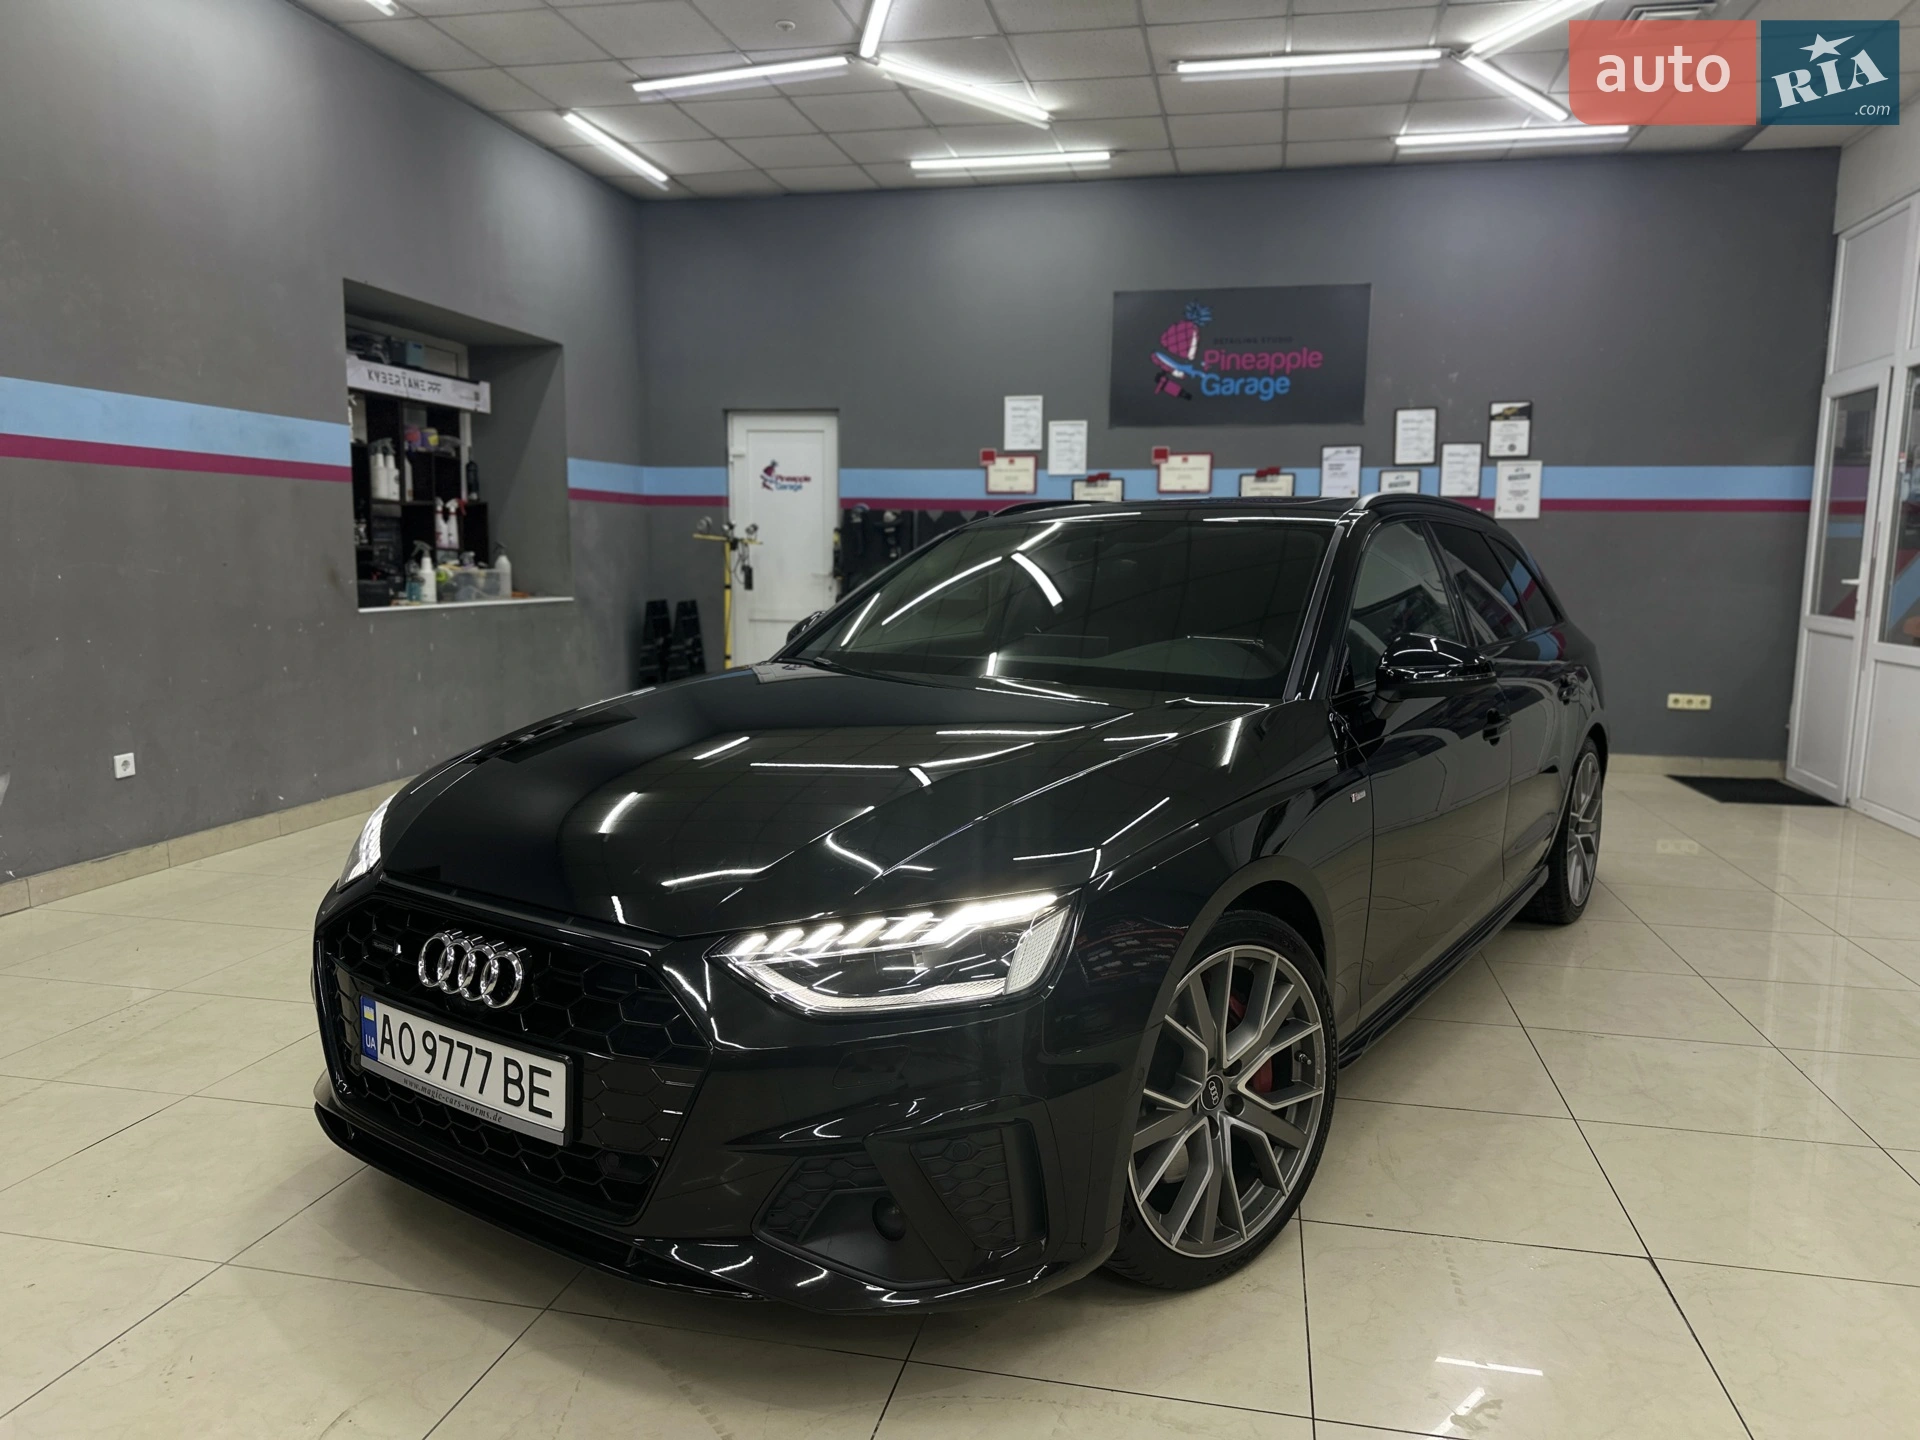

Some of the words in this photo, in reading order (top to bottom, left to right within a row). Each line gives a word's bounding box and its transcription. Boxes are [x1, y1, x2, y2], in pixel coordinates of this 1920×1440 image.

[1203, 346, 1323, 375] Pineapple
[1201, 373, 1290, 401] Garage
[776, 474, 812, 483] Pineapple
[365, 1033, 377, 1051] UA
[380, 1014, 415, 1065] AO
[422, 1030, 492, 1095] 9777
[503, 1057, 553, 1119] BE
[403, 1077, 503, 1123] www.magic-cars-worms.de
